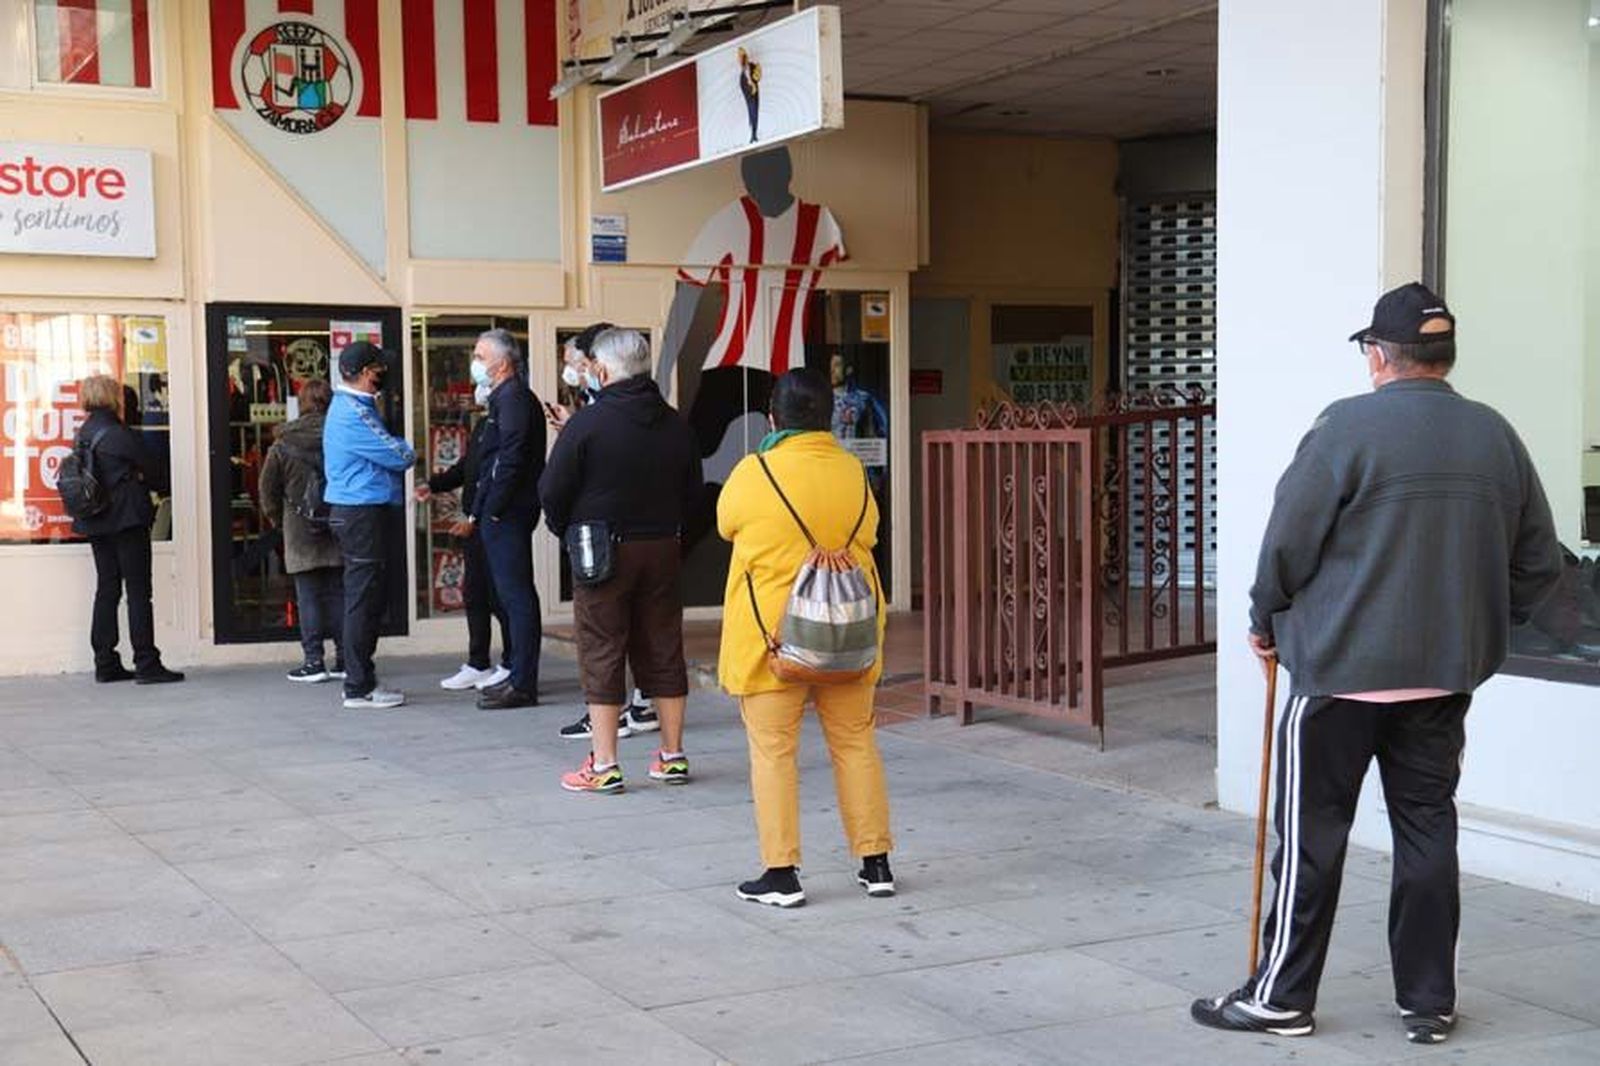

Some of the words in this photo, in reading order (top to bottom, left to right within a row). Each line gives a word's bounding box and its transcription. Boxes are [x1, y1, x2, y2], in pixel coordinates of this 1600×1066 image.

[256, 108, 317, 135] ZAMORA
[0, 157, 126, 199] store
[13, 201, 121, 237] sentimos
